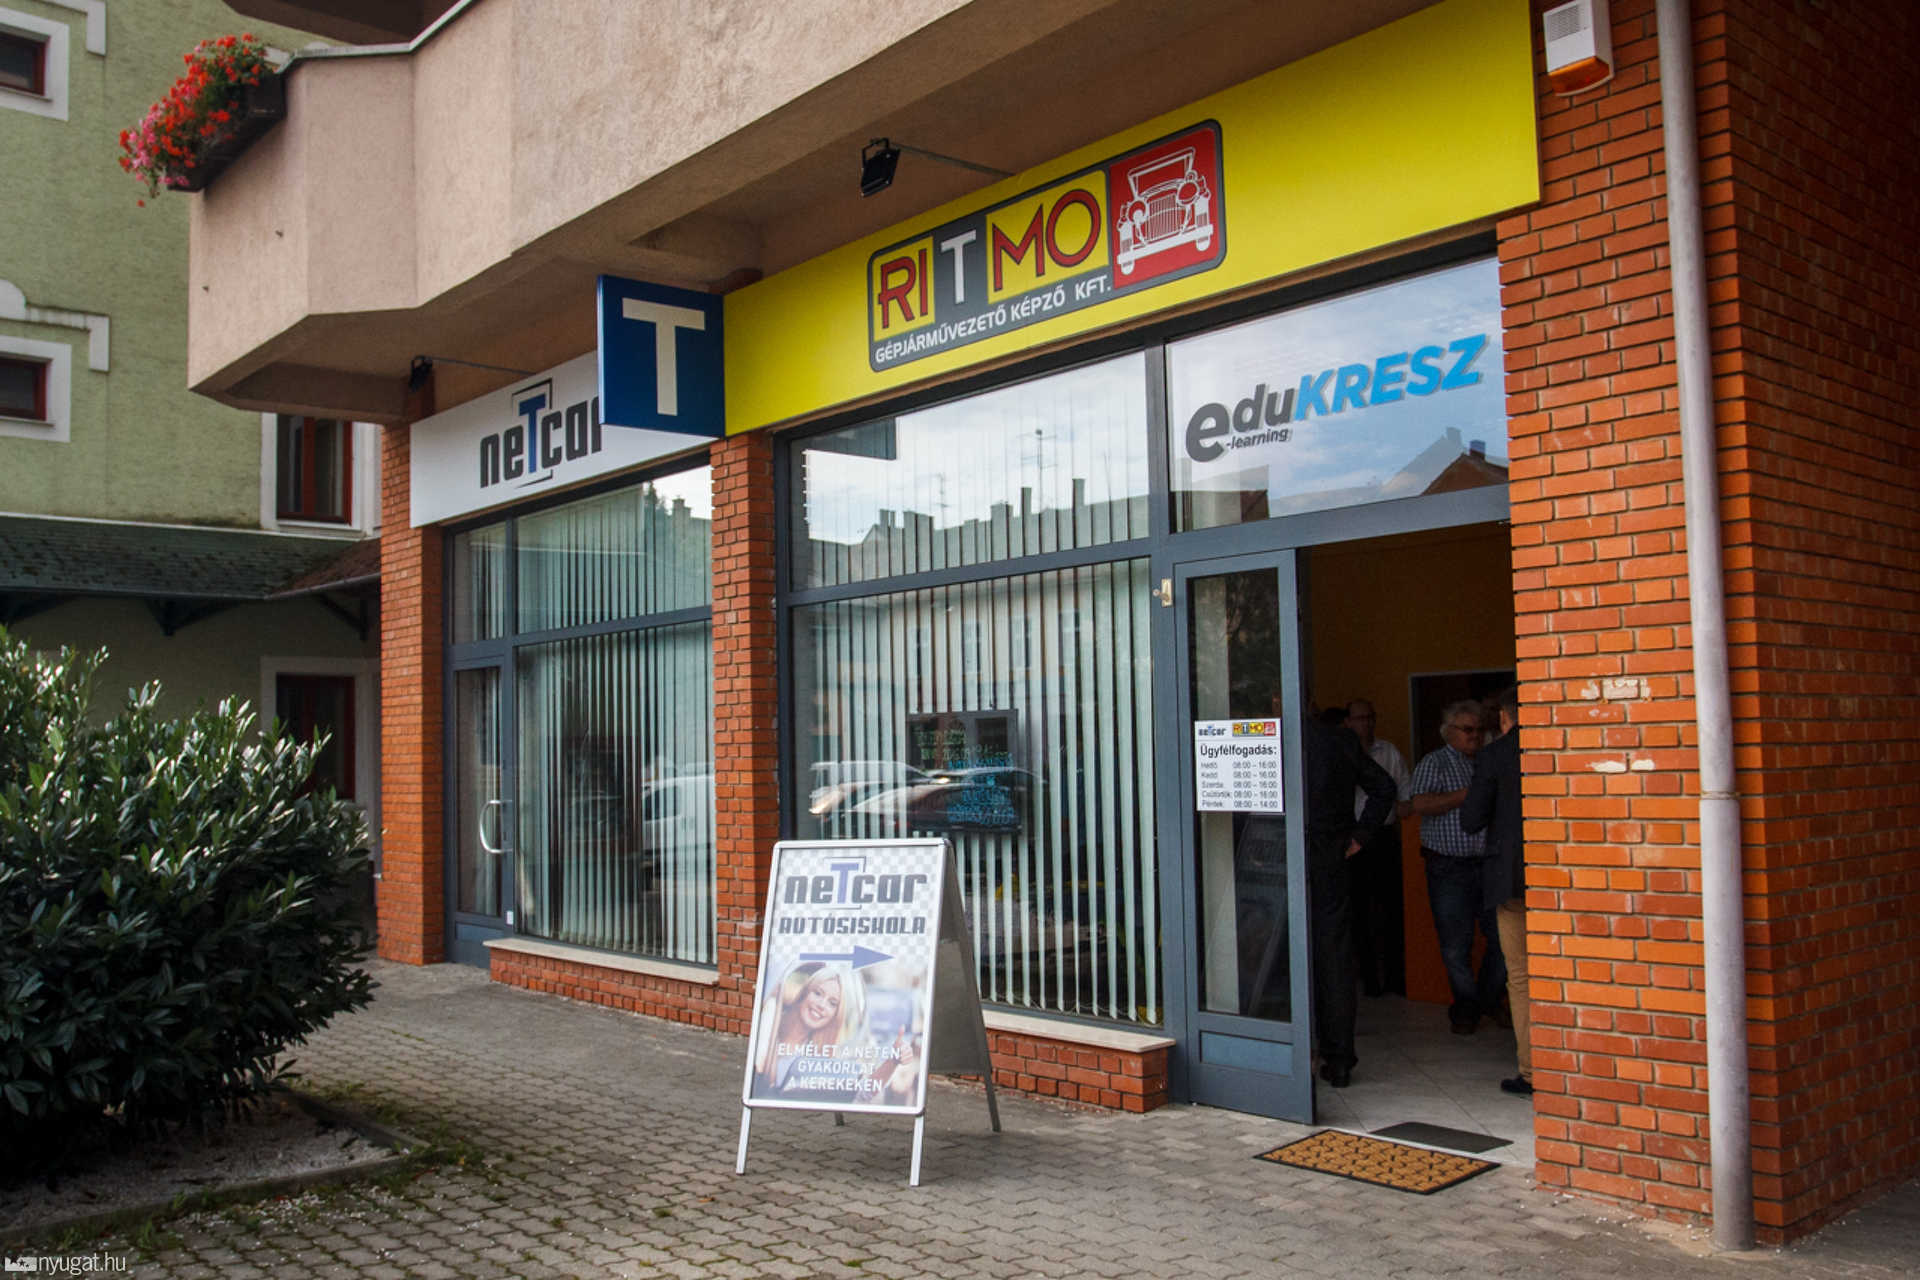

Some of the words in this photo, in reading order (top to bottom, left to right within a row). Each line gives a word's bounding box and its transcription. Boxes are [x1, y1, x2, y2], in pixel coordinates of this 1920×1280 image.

[878, 189, 1101, 329] RITMO
[874, 303, 1007, 364] GÉPJÁRMŰVEZETŐ
[1010, 284, 1066, 321] KÉPZŐ
[1075, 274, 1112, 301] KFT.
[622, 297, 706, 416] T
[1200, 743, 1277, 758] Ügyfélfogadás:
[778, 913, 927, 935] AUTÓSISKOLA
[777, 1040, 838, 1058] ELMÉLET
[841, 1046, 850, 1058] A
[855, 1045, 900, 1060] NETEN
[798, 1060, 875, 1075] GYAKORLAT
[787, 1076, 797, 1090] A
[800, 1077, 883, 1092] KEREKEKEN
